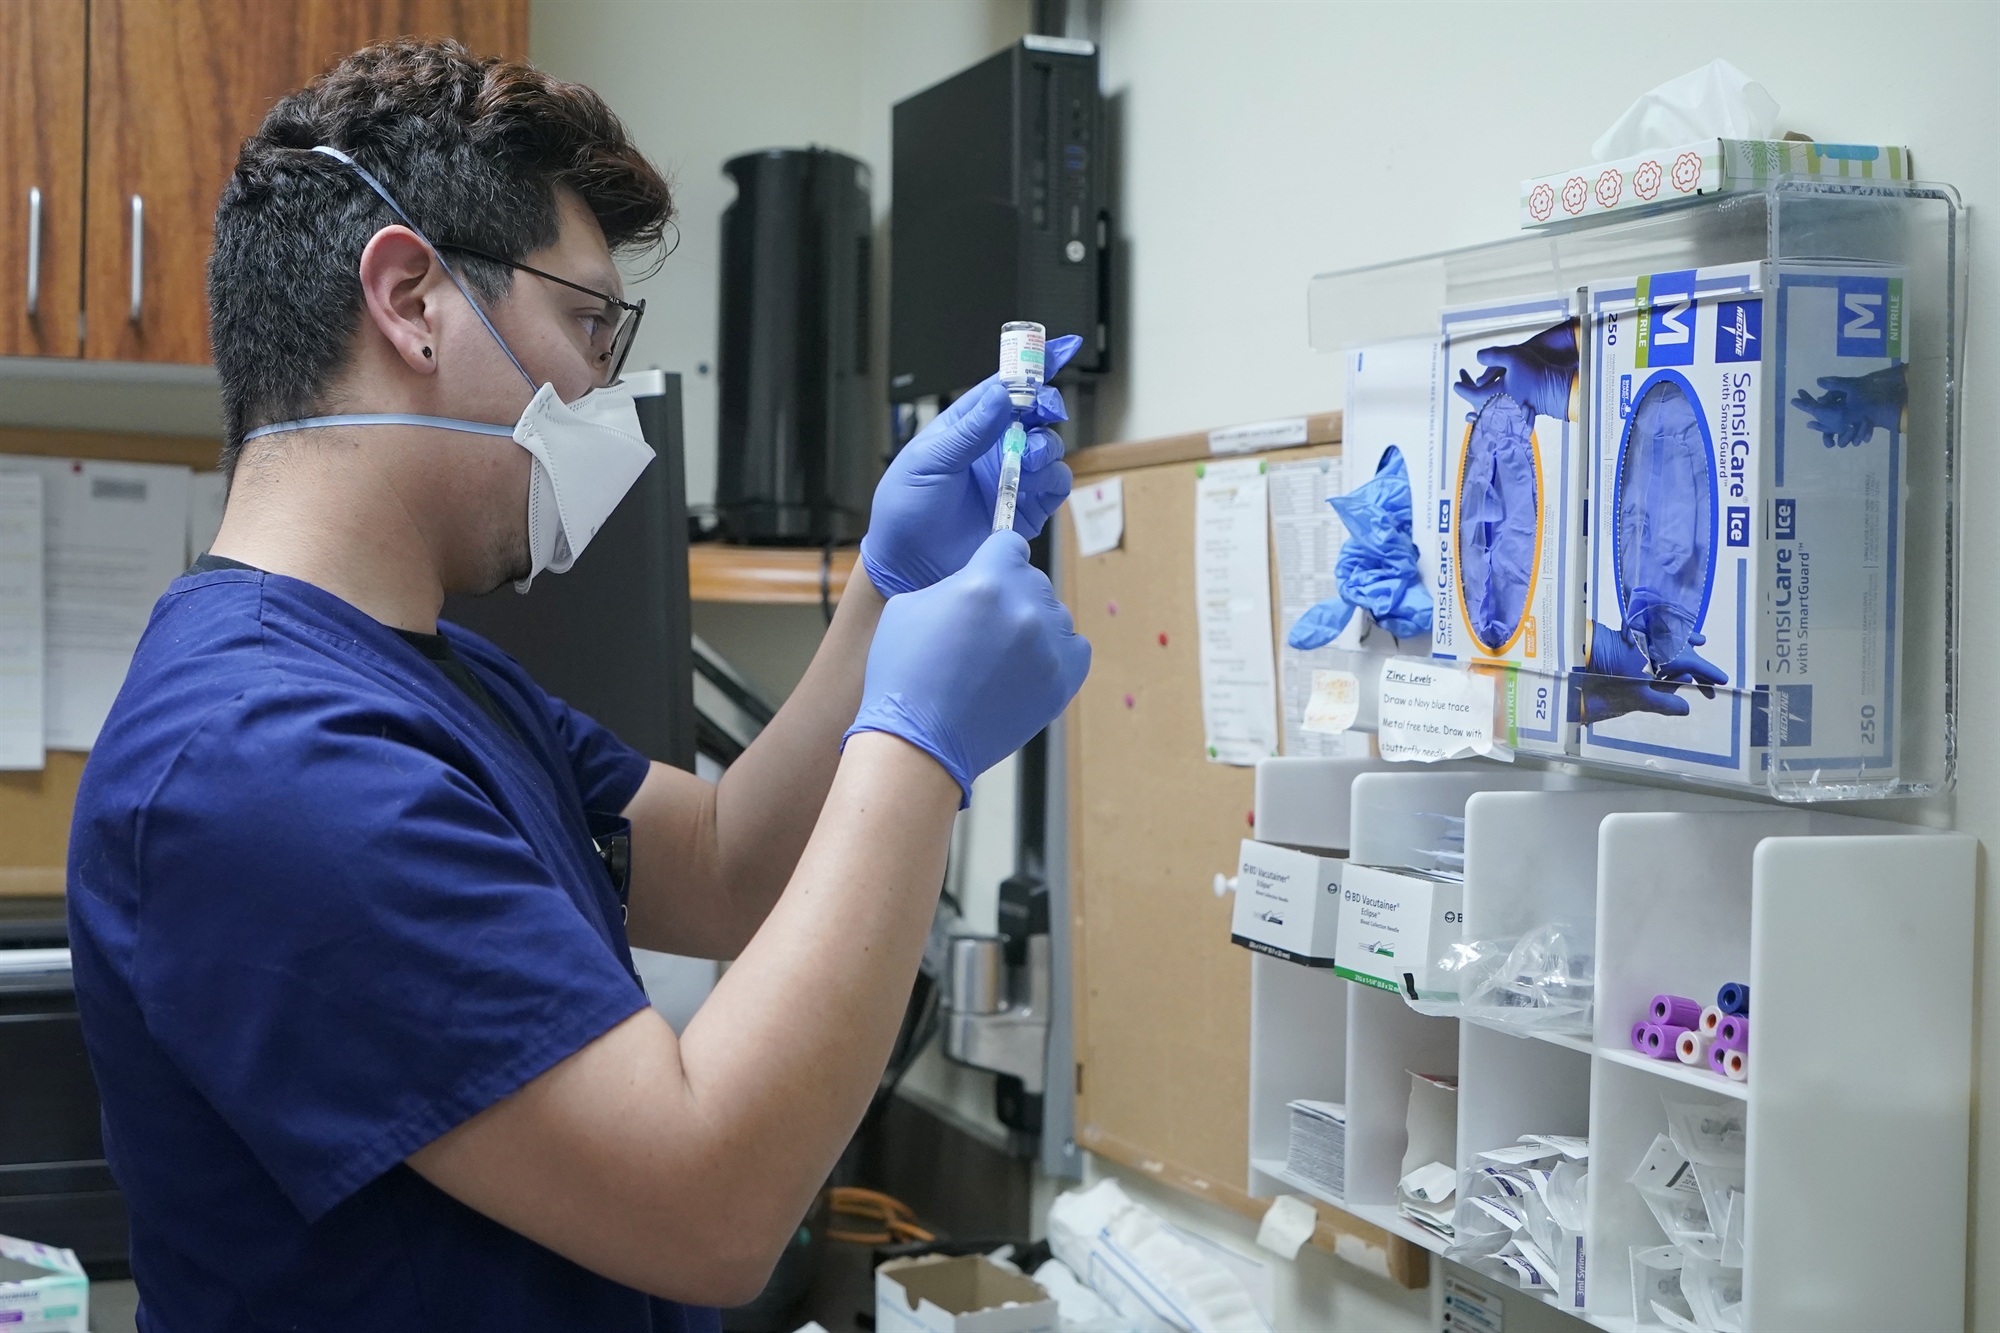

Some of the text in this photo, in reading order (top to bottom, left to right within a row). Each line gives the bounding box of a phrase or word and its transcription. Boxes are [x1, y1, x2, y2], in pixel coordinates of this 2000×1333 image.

[1608, 312, 1618, 347] 250
[1653, 292, 1691, 347] M
[1843, 293, 1883, 339] M
[1889, 294, 1900, 341] NITRILE
[1734, 305, 1745, 358] MEDLINE
[1722, 372, 1732, 401] with
[1440, 504, 1448, 529] Ice
[1730, 512, 1746, 542] Ice
[1777, 504, 1791, 534] Ice
[1796, 642, 1809, 675] with
[1386, 670, 1406, 682] Zinc
[1409, 672, 1432, 684] Levels
[1384, 694, 1406, 706] Draw
[1414, 698, 1430, 710] Navy
[1431, 699, 1446, 710] blue
[1448, 702, 1470, 712] trace
[1536, 687, 1548, 720] 250
[1780, 690, 1790, 742] MEDLINE
[1382, 718, 1406, 730] Metal
[1406, 720, 1421, 731] free
[1443, 724, 1464, 737] Draw
[1466, 729, 1482, 738] with
[1860, 704, 1876, 745] 250
[1386, 742, 1421, 756] butterfly
[1250, 865, 1257, 875] BD
[1352, 892, 1361, 902] BD
[1370, 920, 1386, 930] Collection
[1576, 1280, 1585, 1296] 3ml
